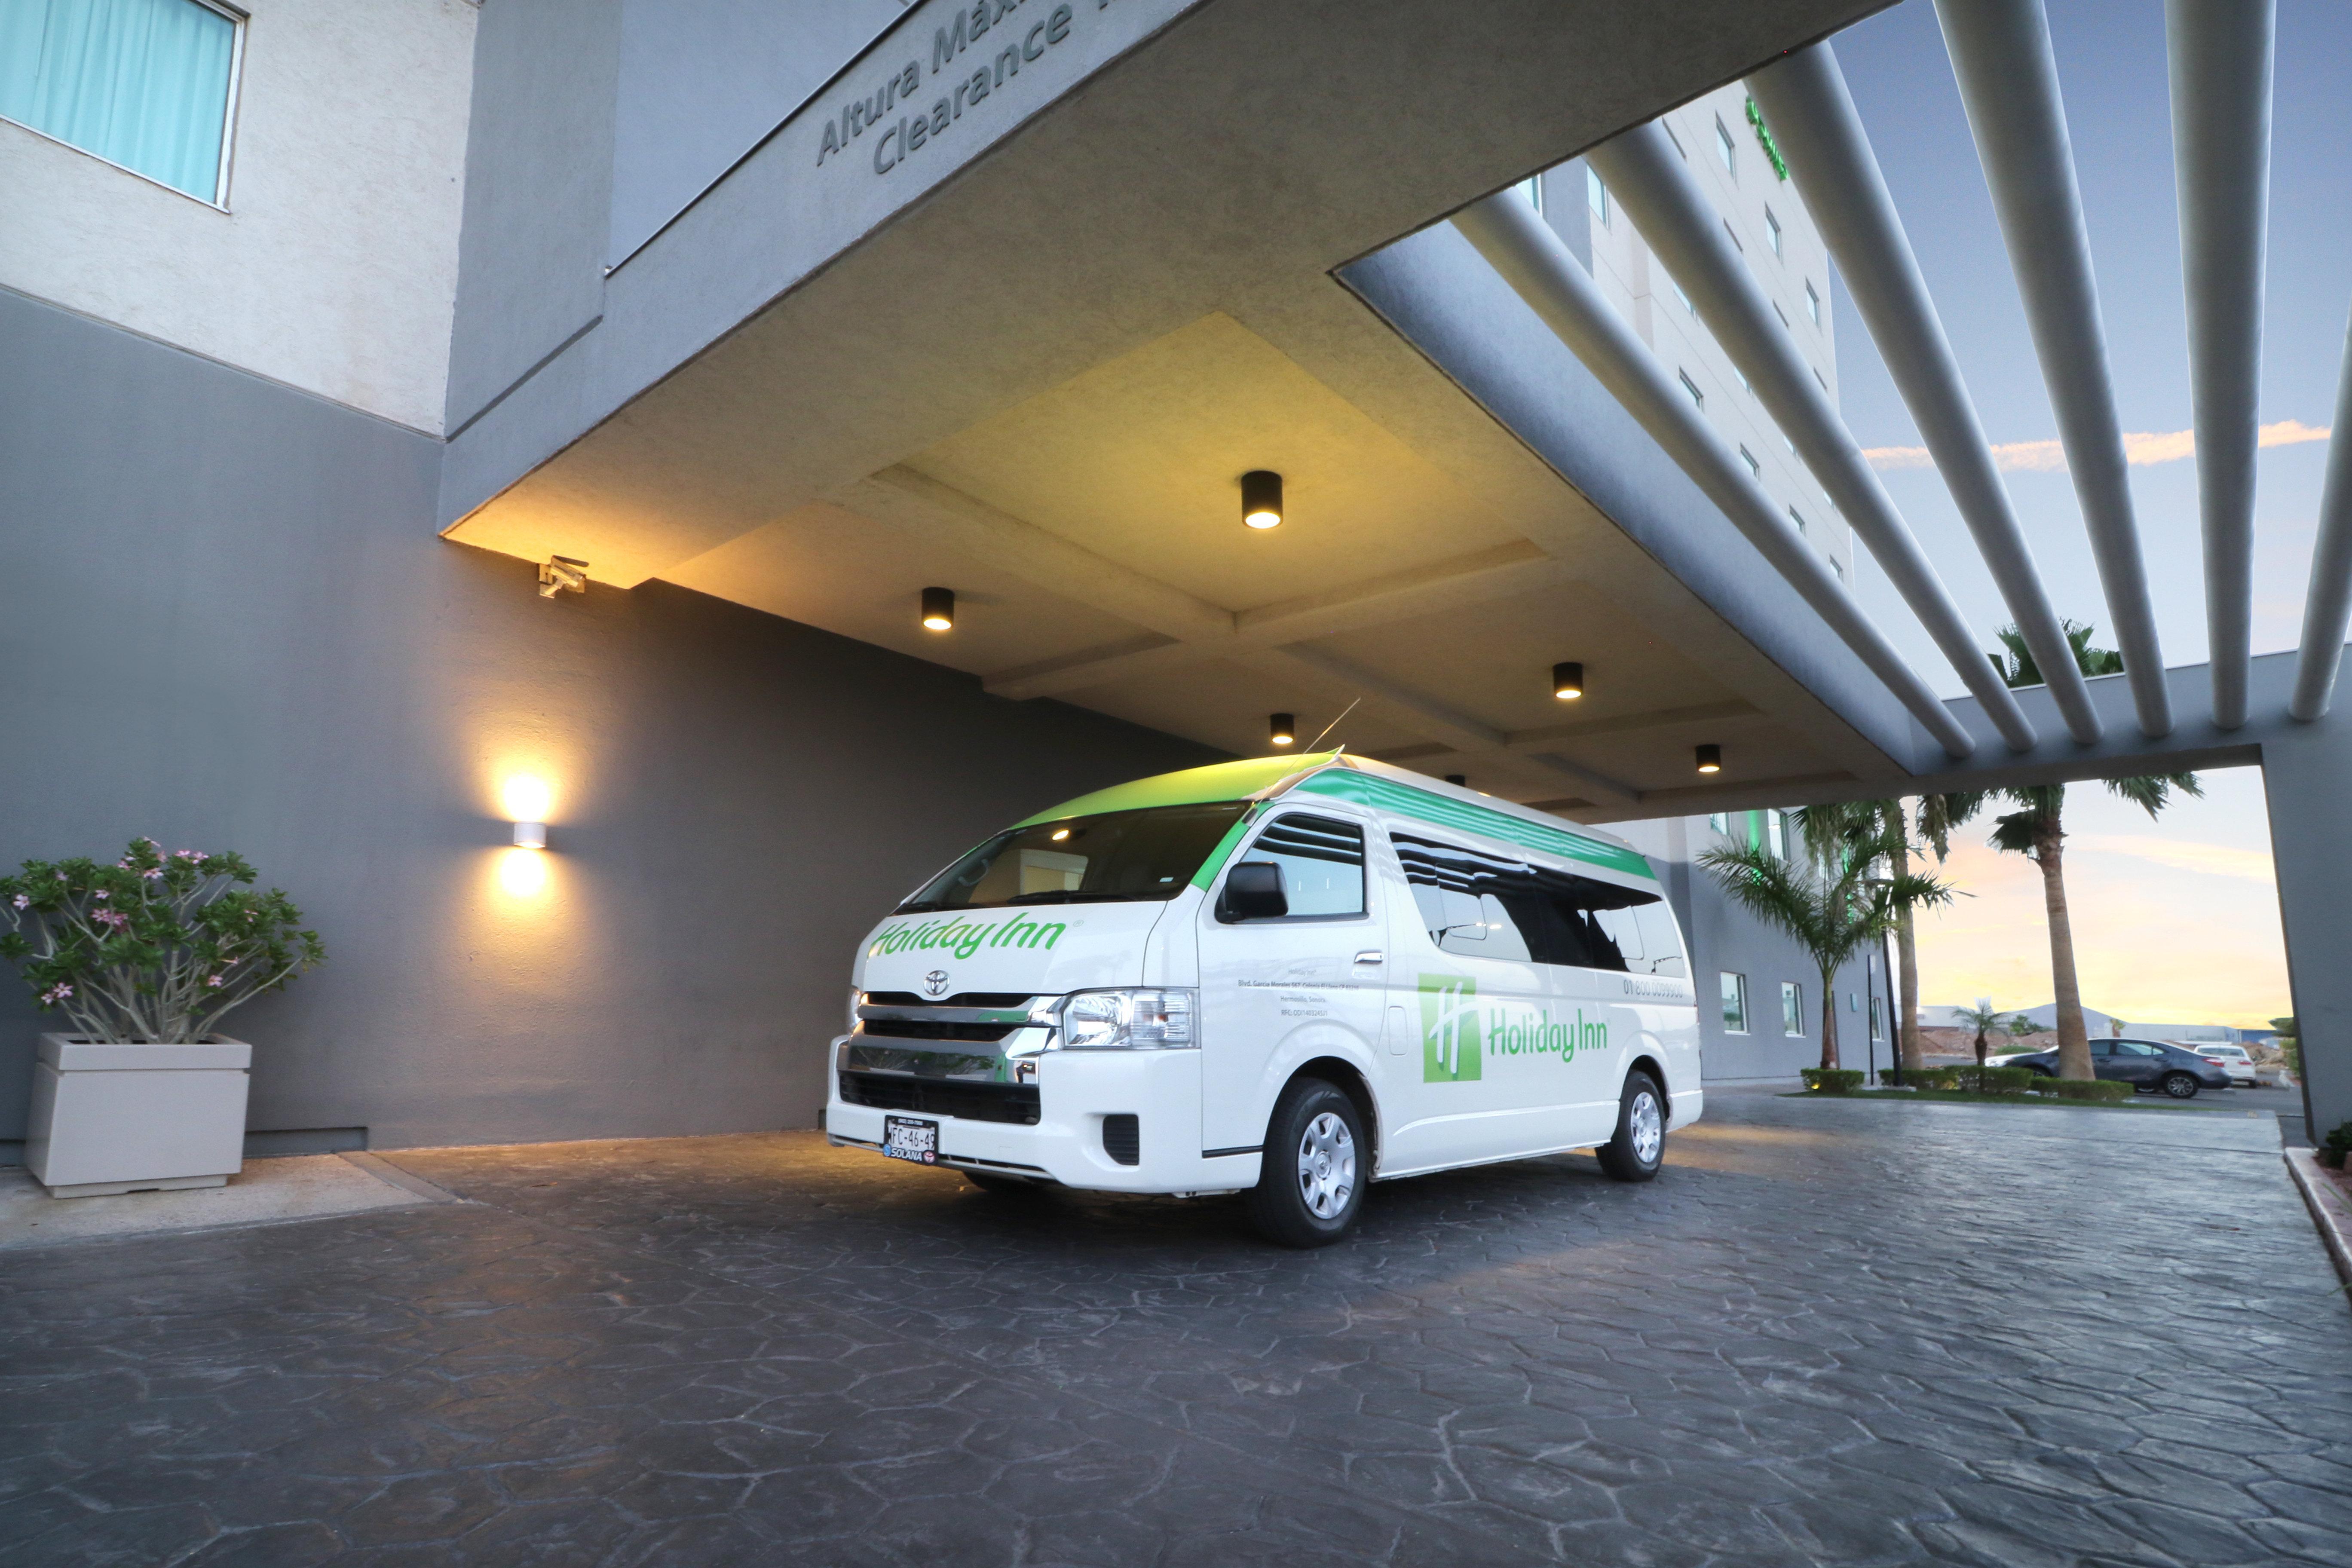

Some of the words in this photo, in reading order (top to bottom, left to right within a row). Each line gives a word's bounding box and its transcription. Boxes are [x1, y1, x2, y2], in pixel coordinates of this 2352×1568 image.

[816, 60, 919, 166] Altura
[873, 3, 1073, 175] Clearance
[867, 916, 996, 960] Holiday
[990, 912, 1066, 950] Inn
[1623, 979, 1633, 995] 01
[1636, 981, 1650, 996] 800
[1488, 1008, 1574, 1063] Holiday
[1577, 1008, 1608, 1050] Inn
[891, 1148, 922, 1161] SOLANA
